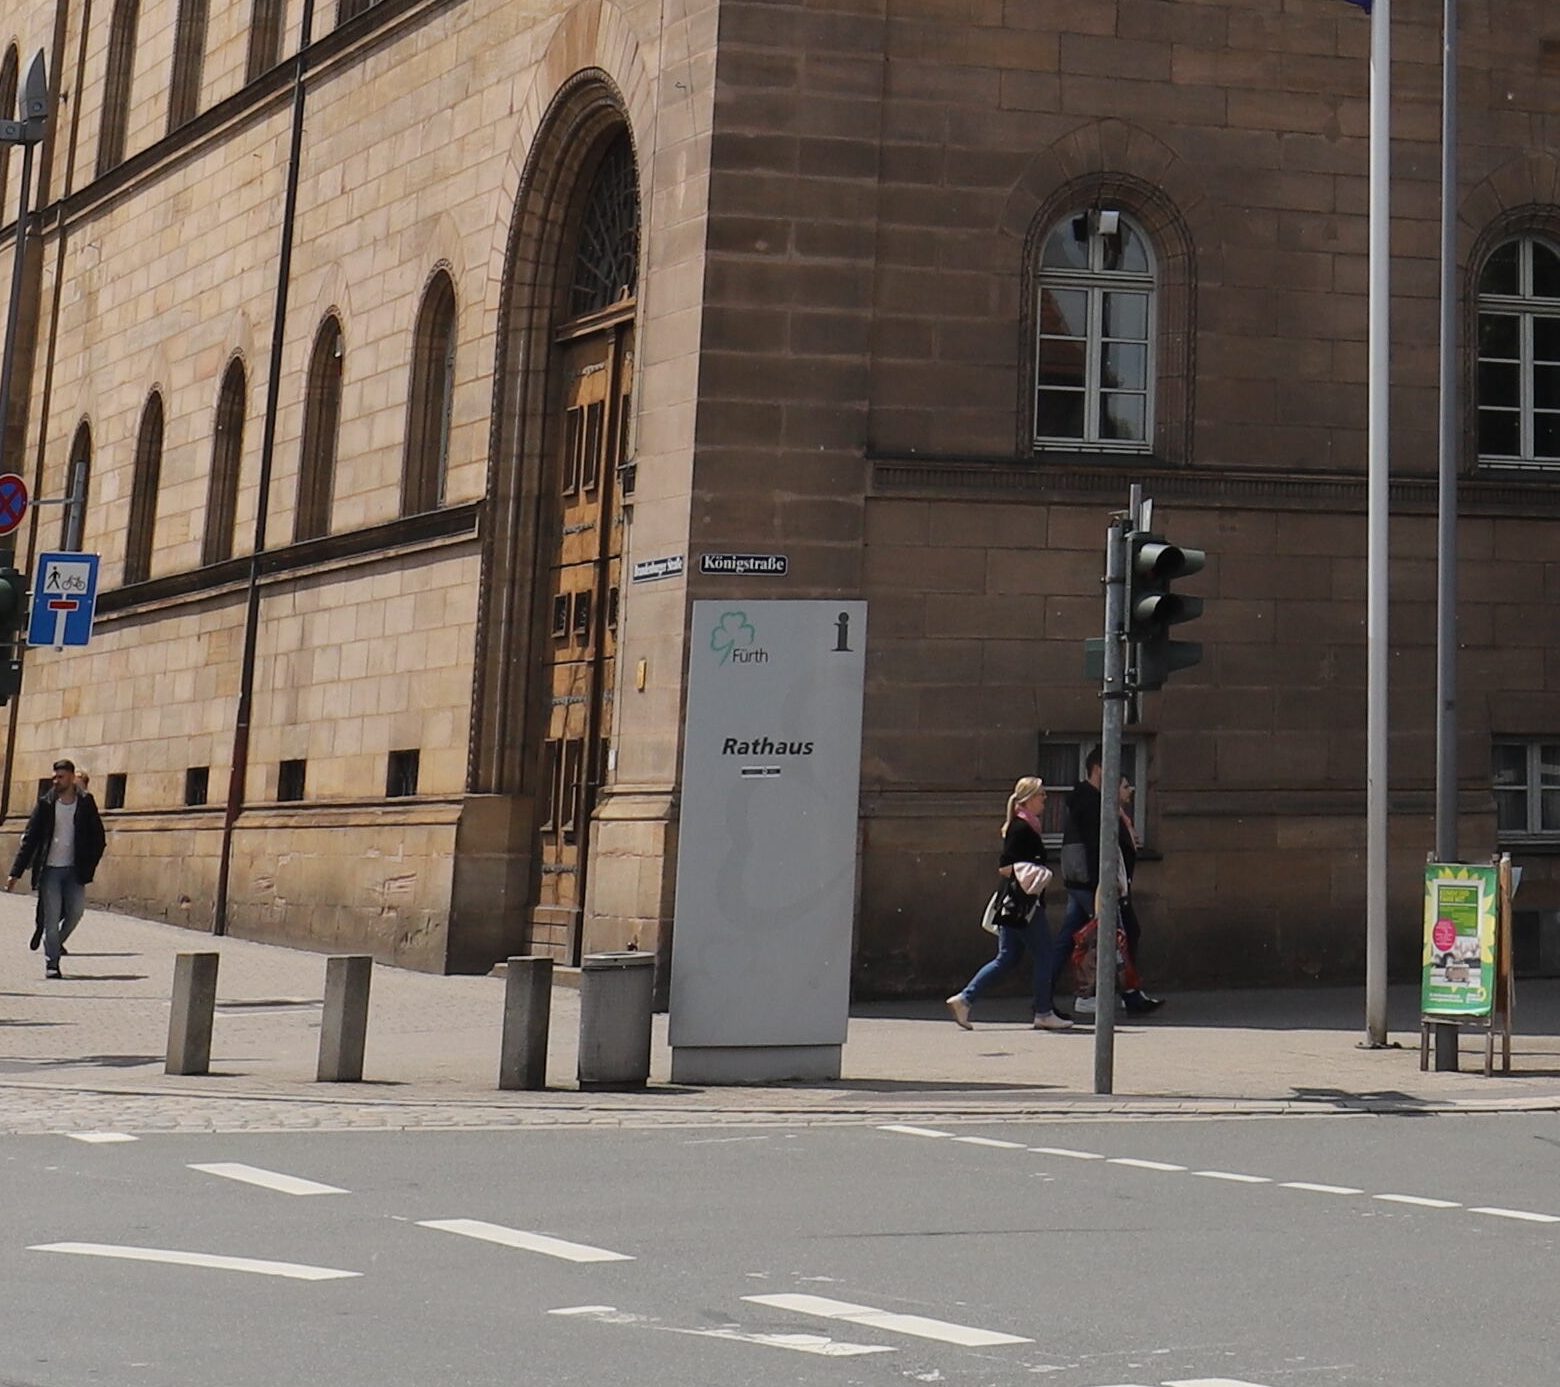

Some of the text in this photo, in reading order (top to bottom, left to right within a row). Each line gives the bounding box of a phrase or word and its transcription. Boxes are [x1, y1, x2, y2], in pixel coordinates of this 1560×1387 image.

[703, 555, 785, 573] Königstraße
[732, 647, 769, 664] Fürth
[721, 737, 814, 756] Rathaus
